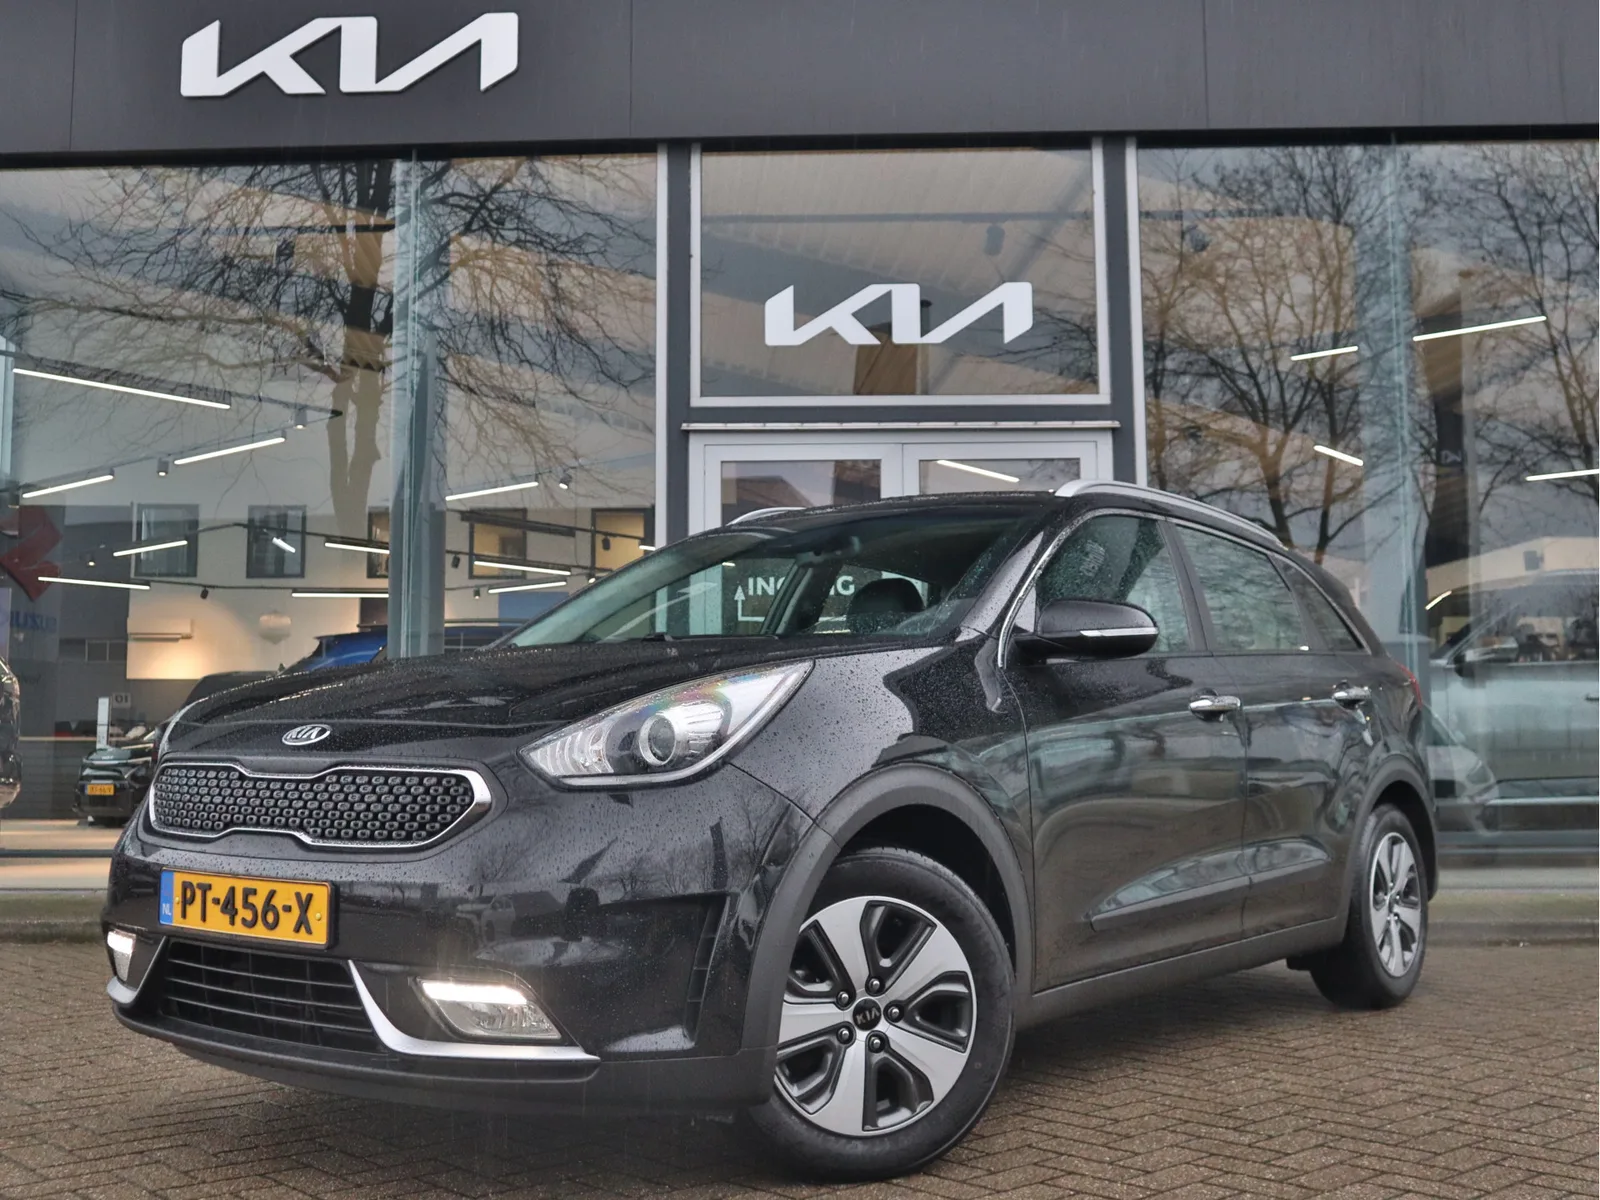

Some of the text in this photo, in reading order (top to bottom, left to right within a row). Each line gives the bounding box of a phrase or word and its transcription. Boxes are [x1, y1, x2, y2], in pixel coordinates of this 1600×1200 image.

[180, 12, 519, 97] KIA
[764, 281, 1034, 346] KIA
[747, 575, 856, 597] ING
[162, 880, 314, 935] NL PT-456-X
[856, 1007, 880, 1025] KIA
